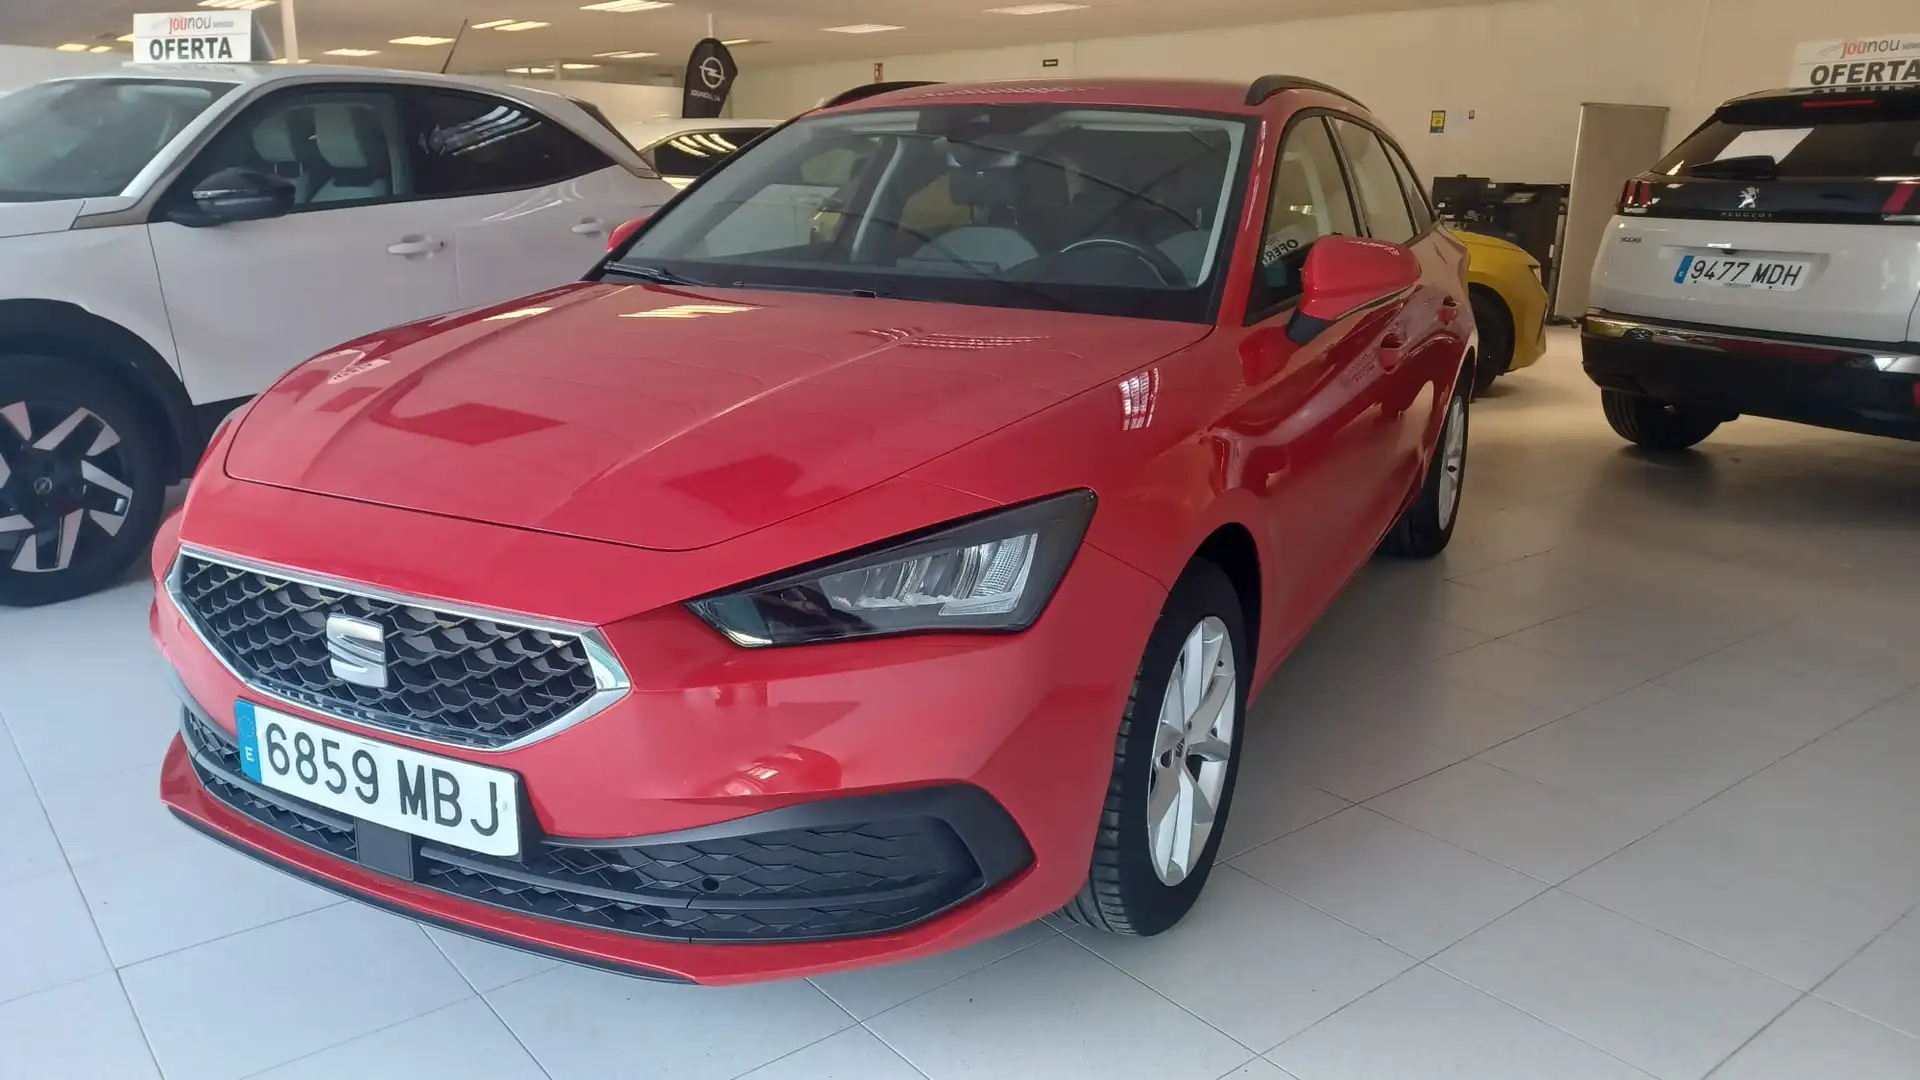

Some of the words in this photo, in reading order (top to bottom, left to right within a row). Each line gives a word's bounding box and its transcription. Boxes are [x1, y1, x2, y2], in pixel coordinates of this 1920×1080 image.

[149, 36, 233, 61] OFERTA
[1840, 39, 1901, 60] jounou
[1810, 59, 1920, 86] OFERTA
[1690, 259, 1750, 281] 9477
[1751, 263, 1802, 286] MDH
[245, 746, 255, 762] E
[265, 722, 380, 805] 6859
[396, 759, 500, 837] MBJ
